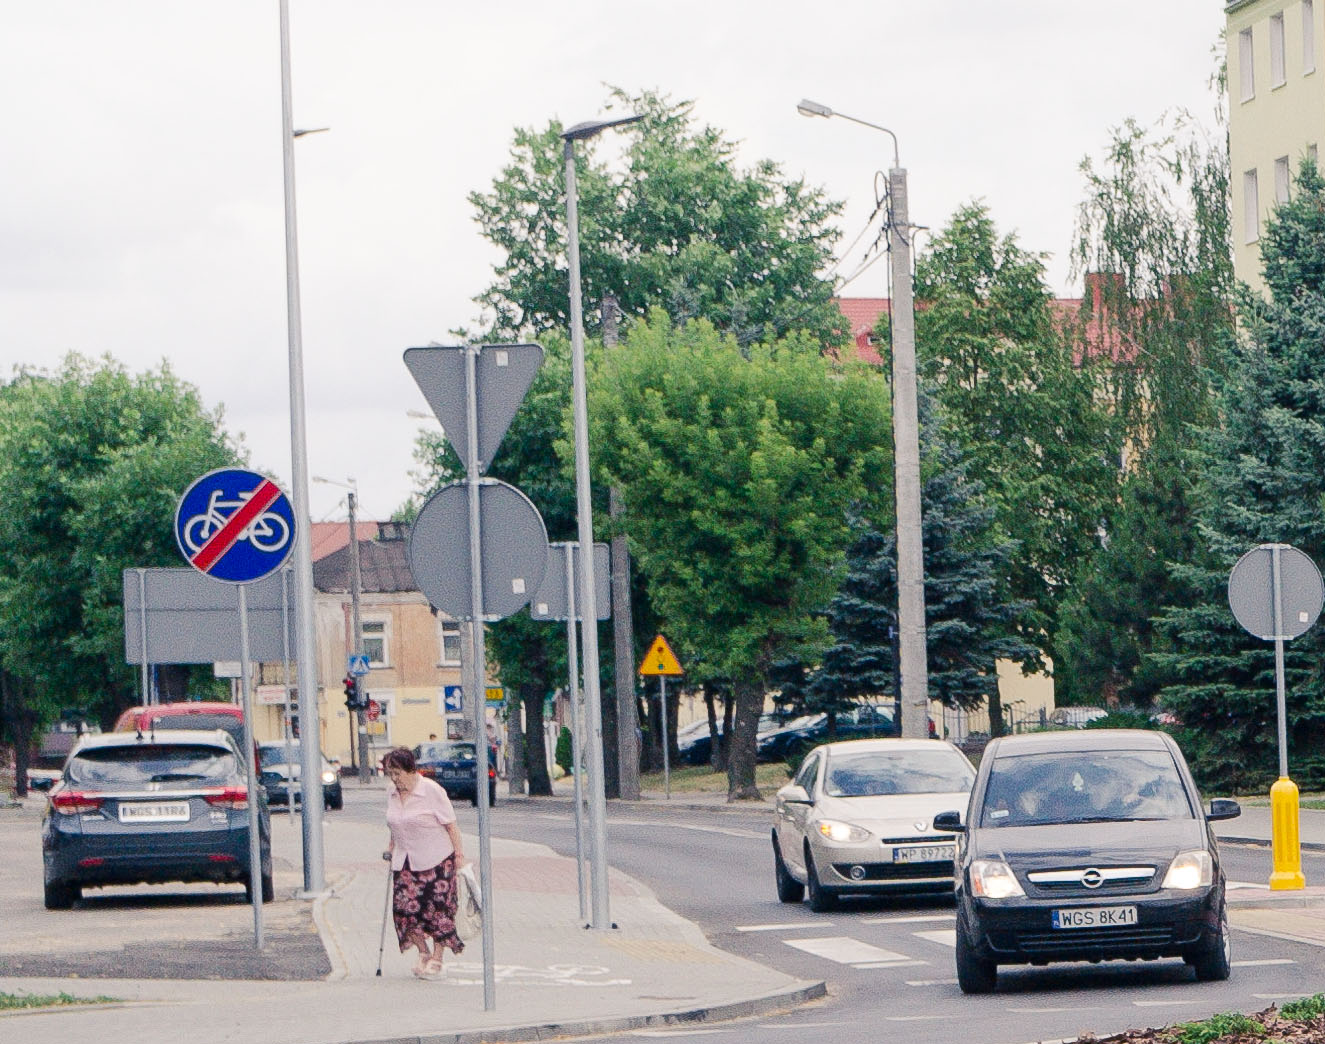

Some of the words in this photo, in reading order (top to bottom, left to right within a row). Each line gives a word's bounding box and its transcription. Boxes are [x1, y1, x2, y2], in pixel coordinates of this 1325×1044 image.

[901, 848, 917, 859] WP
[920, 847, 955, 859] 89722
[1062, 911, 1094, 926] WGS
[1100, 908, 1134, 924] 8K41
